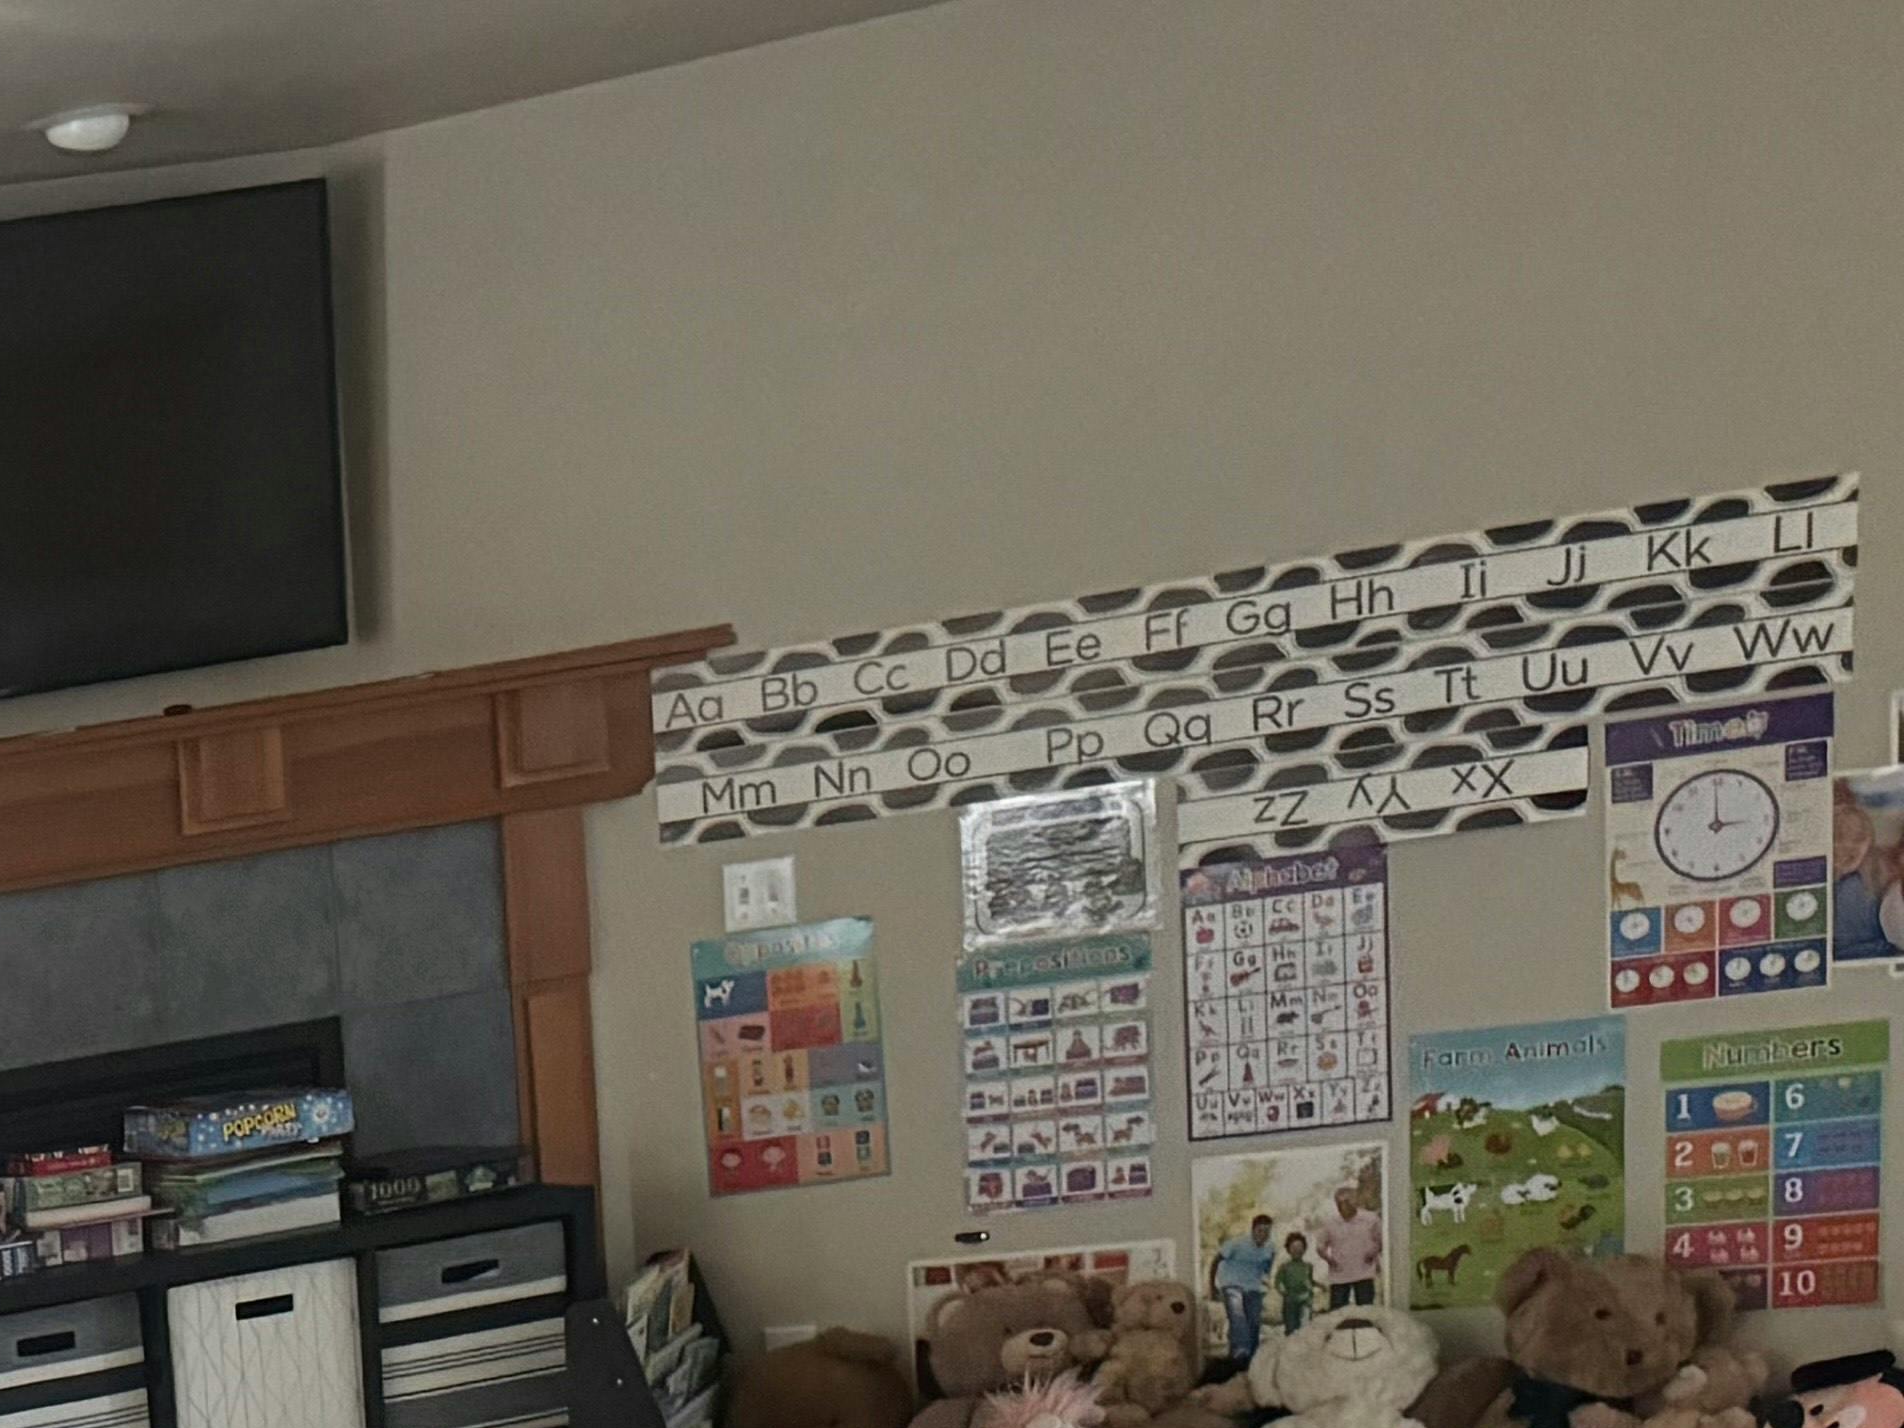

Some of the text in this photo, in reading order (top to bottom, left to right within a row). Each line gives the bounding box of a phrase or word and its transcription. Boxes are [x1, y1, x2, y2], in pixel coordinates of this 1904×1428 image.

[665, 511, 1814, 729] Aa Bb Cc Dd Ee Ff Gg Hh Ii Jj Kk Ll
[701, 617, 1836, 813] Mm Nn Oo Pp Qq Rr Ss Tt Uu Vv Ww
[1226, 856, 1340, 895] Alphabet
[1422, 1035, 1607, 1069] Farm Animals
[1702, 1038, 1841, 1071] Numbers
[1676, 1093, 1692, 1120] 1
[1785, 1082, 1805, 1110] 6
[223, 1103, 297, 1142] POPCORN
[1674, 1141, 1694, 1167] 2
[1784, 1132, 1803, 1158] 7
[1674, 1187, 1694, 1212] 3
[1784, 1177, 1803, 1202] 8
[1673, 1232, 1695, 1258] 4
[1783, 1223, 1803, 1250] 9
[1778, 1269, 1817, 1296] 10
